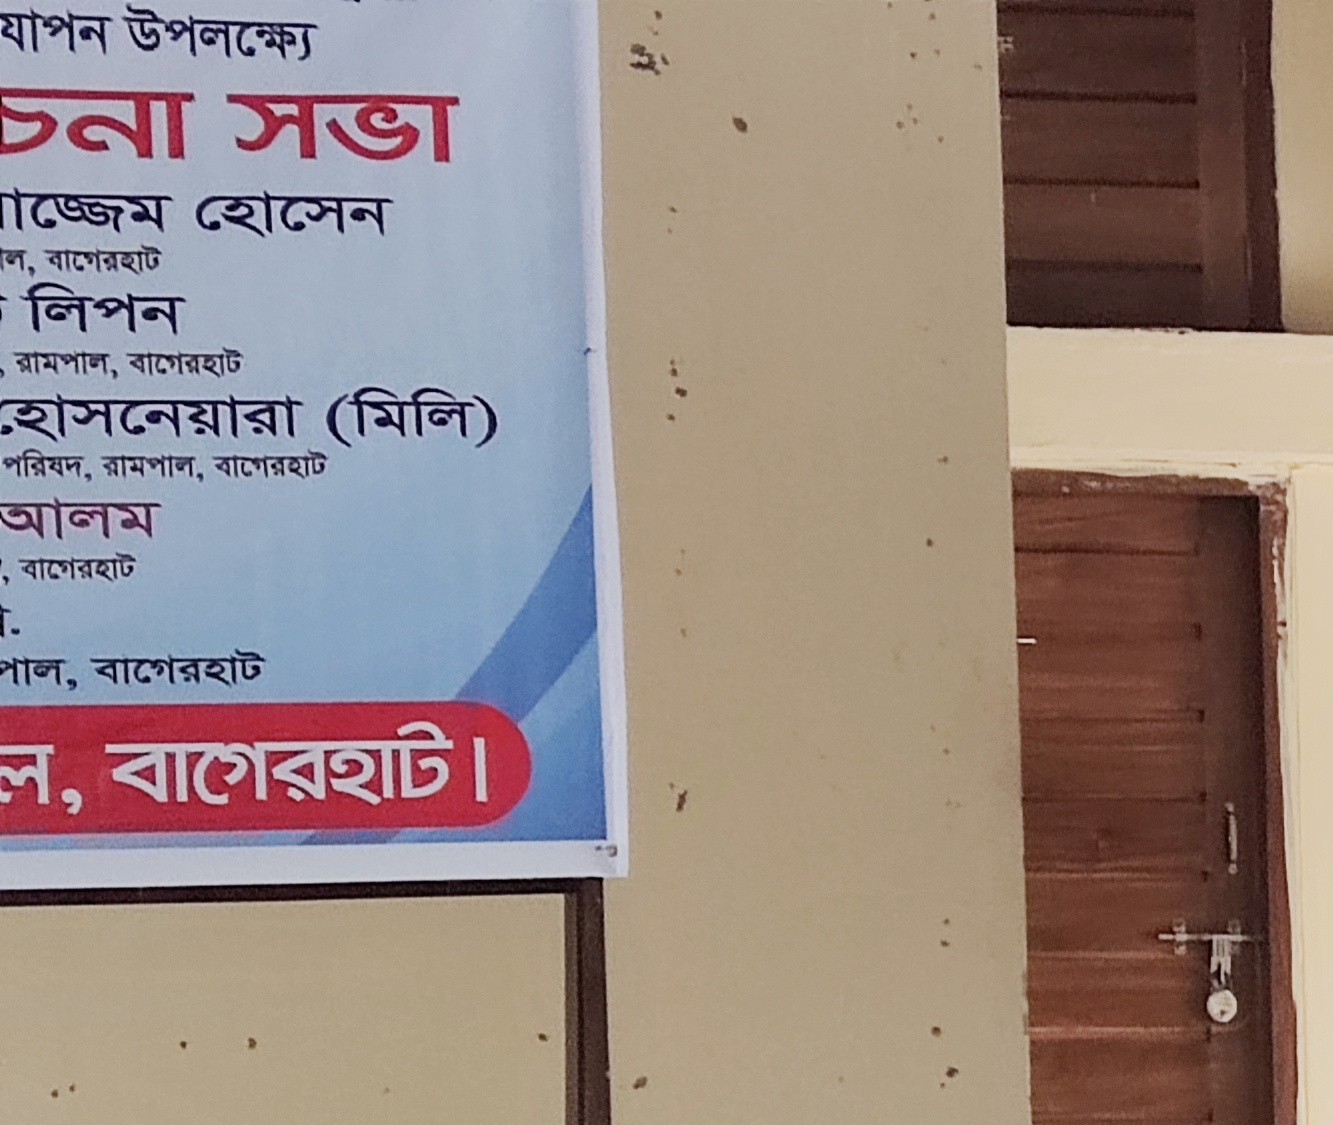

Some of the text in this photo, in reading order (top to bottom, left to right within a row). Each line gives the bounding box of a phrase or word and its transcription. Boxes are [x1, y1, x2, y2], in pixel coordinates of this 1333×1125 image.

[122, 3, 318, 60] উপলক্ষ্যে
[226, 93, 460, 163] সভা
[0, 187, 394, 235] াজ্জেম হোসেন
[44, 245, 162, 275] বাগেরহাট
[20, 282, 186, 335] লিপন
[14, 350, 118, 379] রামপাল,
[126, 347, 244, 378] বাগেরহাট
[325, 386, 499, 448] (মিলি)
[2, 449, 328, 482] পরিষদ, রামপাল, বাগেরহাট
[0, 497, 162, 540] আলম
[18, 552, 137, 581] বাগেরহাট
[90, 653, 266, 687] বাগেরহাট
